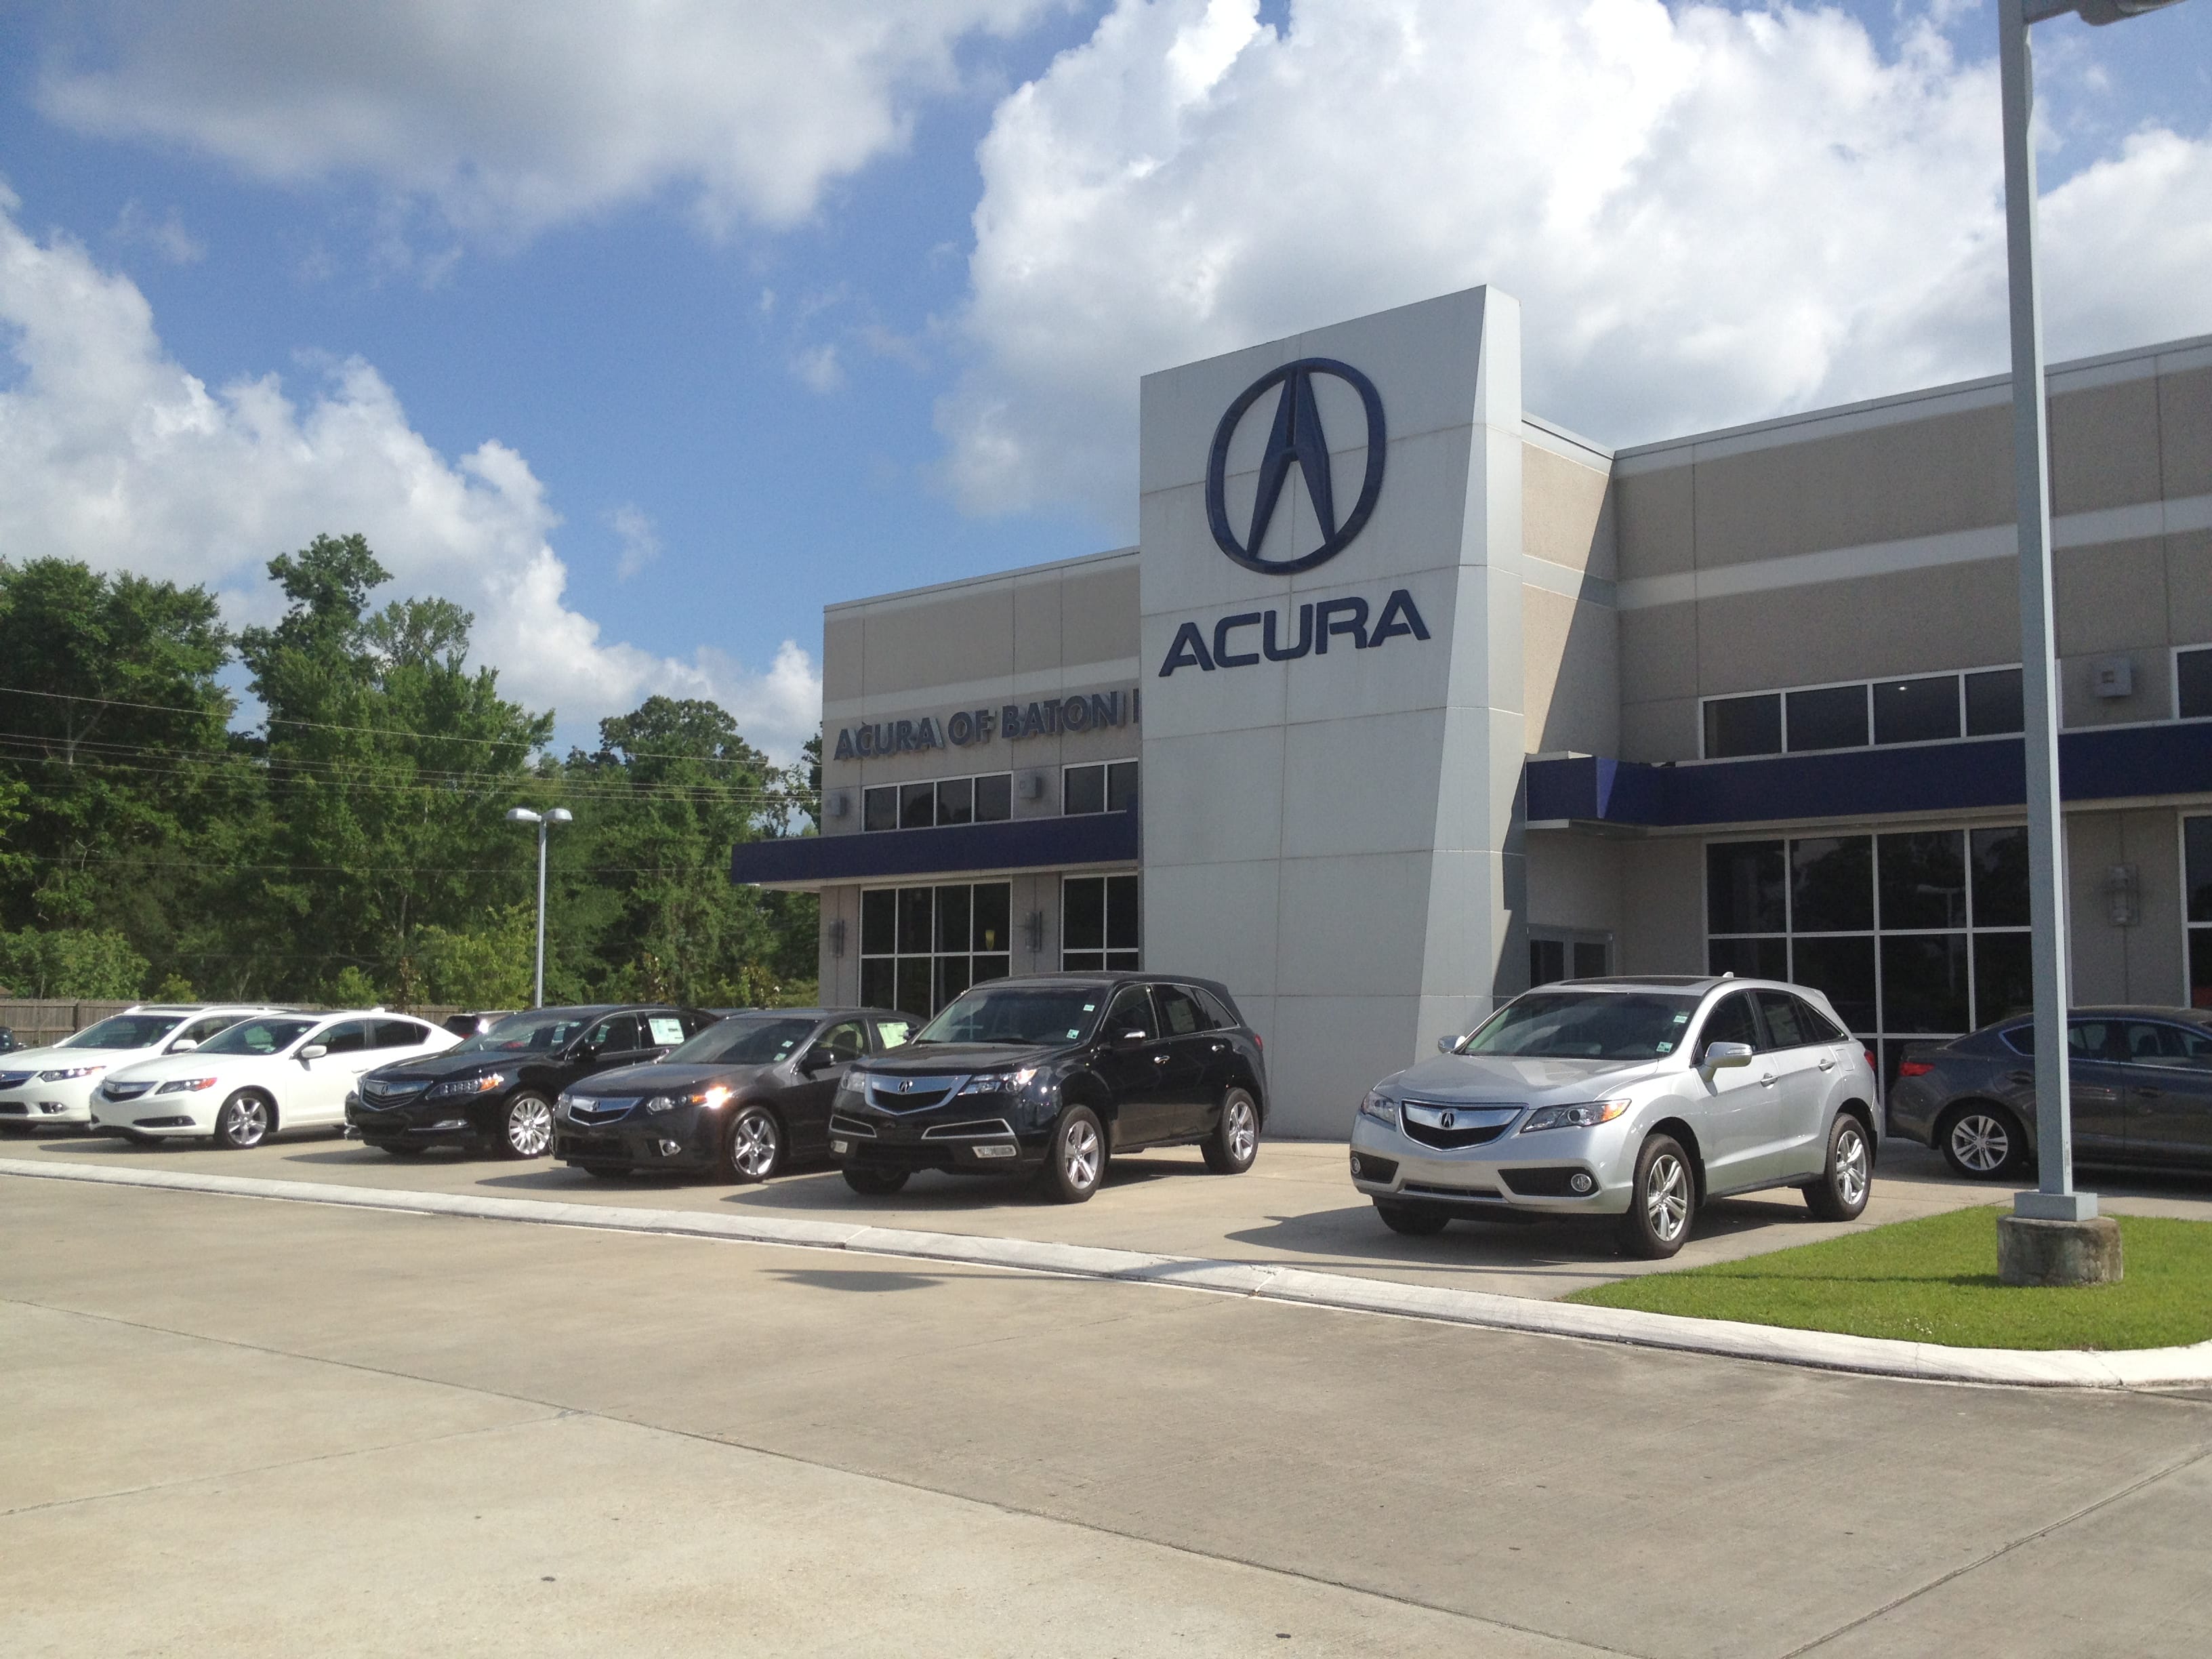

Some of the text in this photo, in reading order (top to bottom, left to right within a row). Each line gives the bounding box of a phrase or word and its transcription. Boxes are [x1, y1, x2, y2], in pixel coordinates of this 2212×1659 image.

[1158, 588, 1431, 677] ACURA
[834, 717, 942, 760] ACURA
[947, 710, 992, 745] OF
[1001, 691, 1122, 738] BATON
